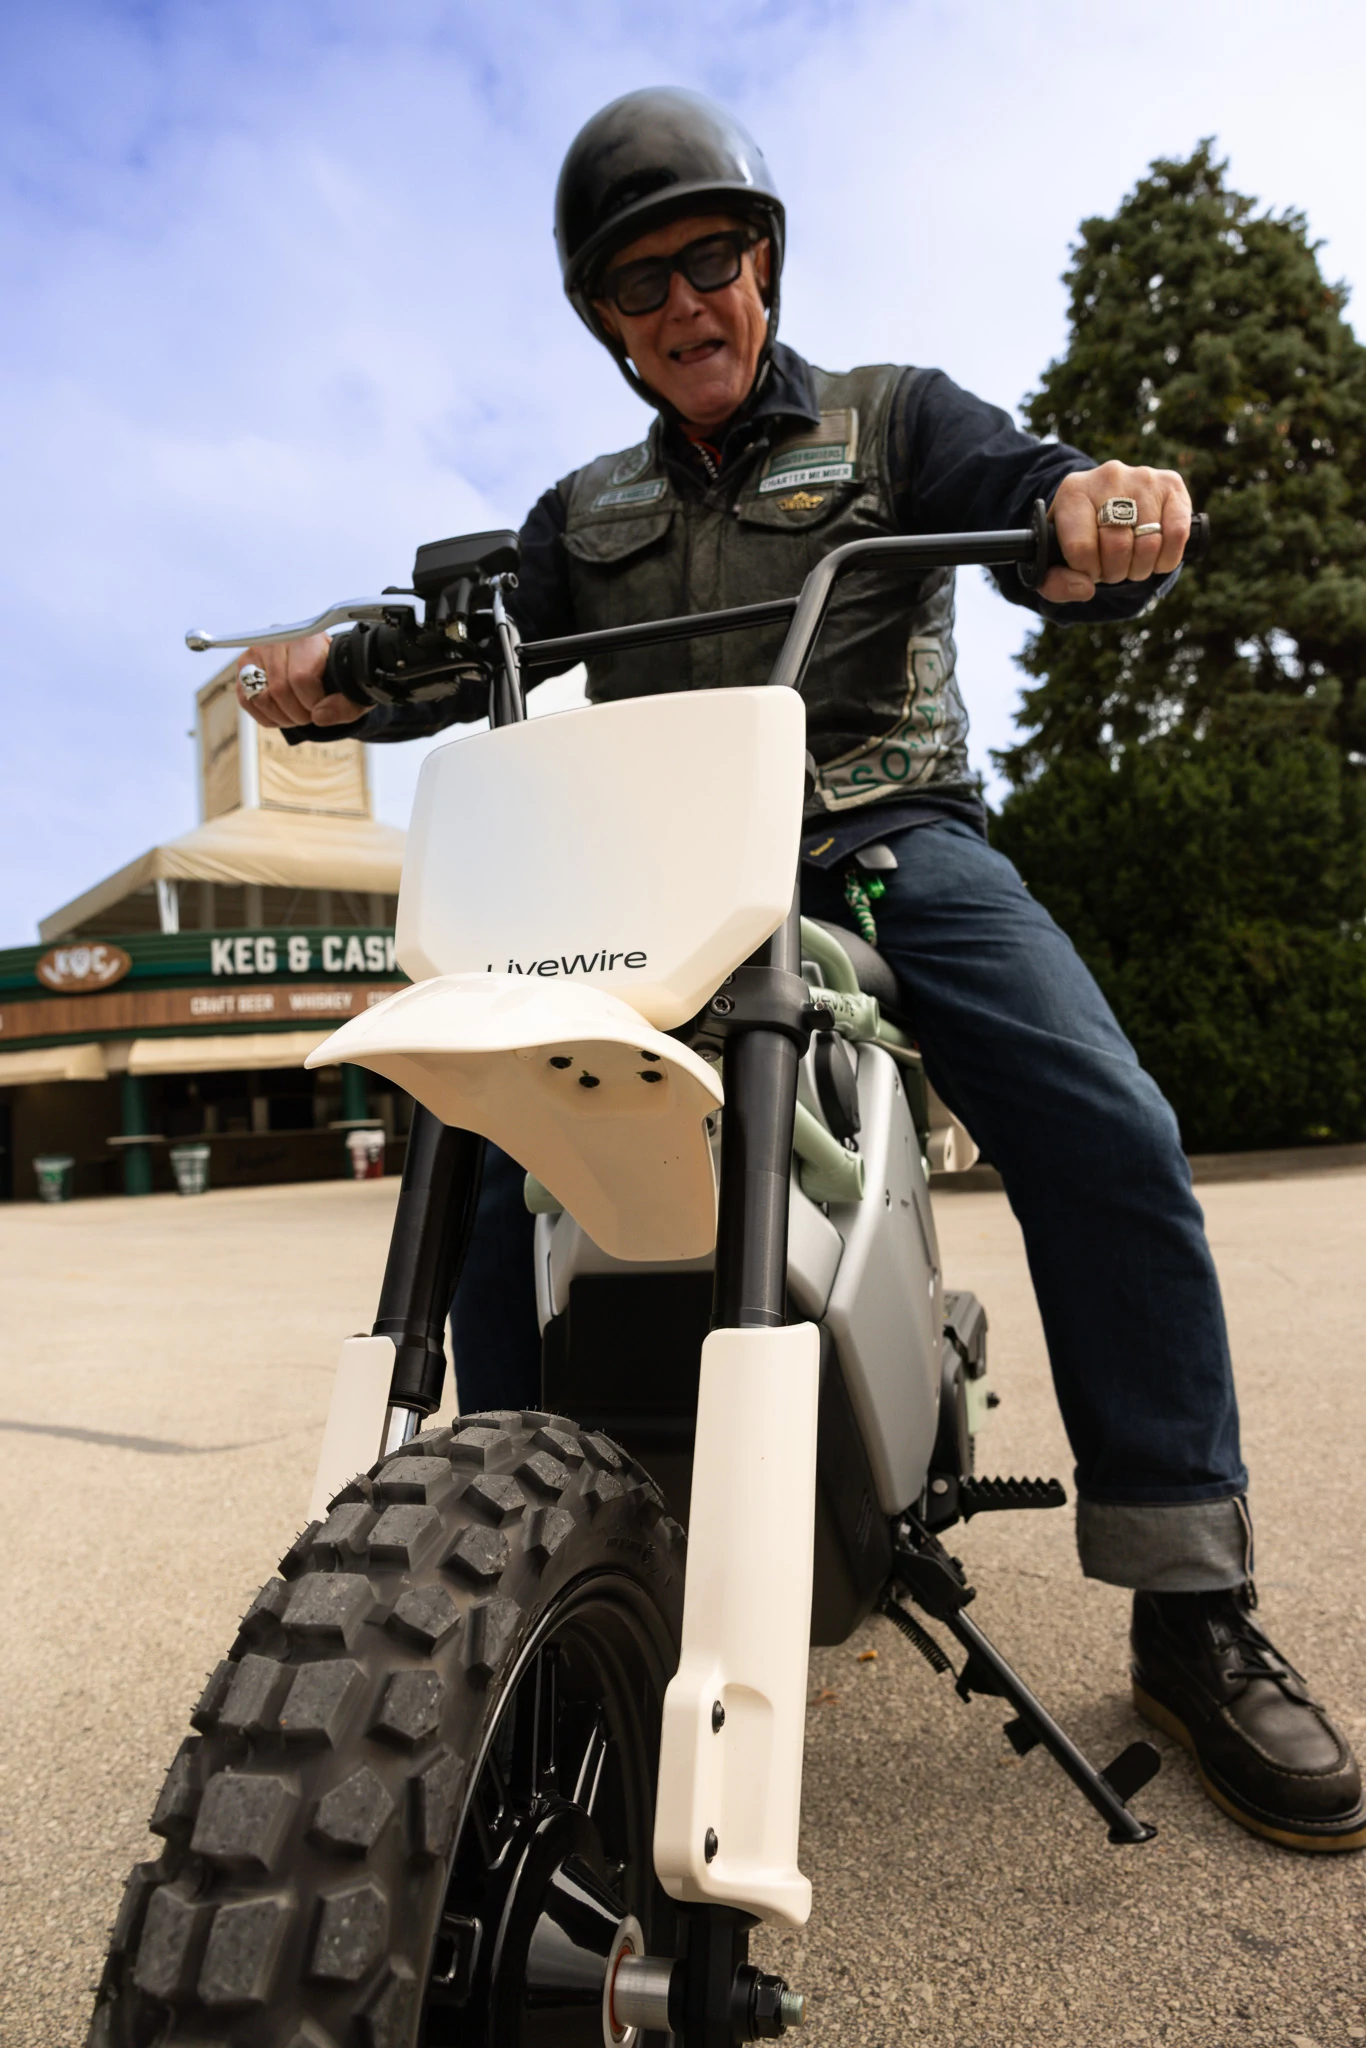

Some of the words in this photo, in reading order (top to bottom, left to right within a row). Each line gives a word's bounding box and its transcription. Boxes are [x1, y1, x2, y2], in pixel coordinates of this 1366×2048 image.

[211, 937, 278, 976] KEG
[287, 936, 312, 972] &
[190, 995, 235, 1015] CRAFT
[237, 993, 274, 1014] BEER
[288, 991, 353, 1011] WHISKEY
